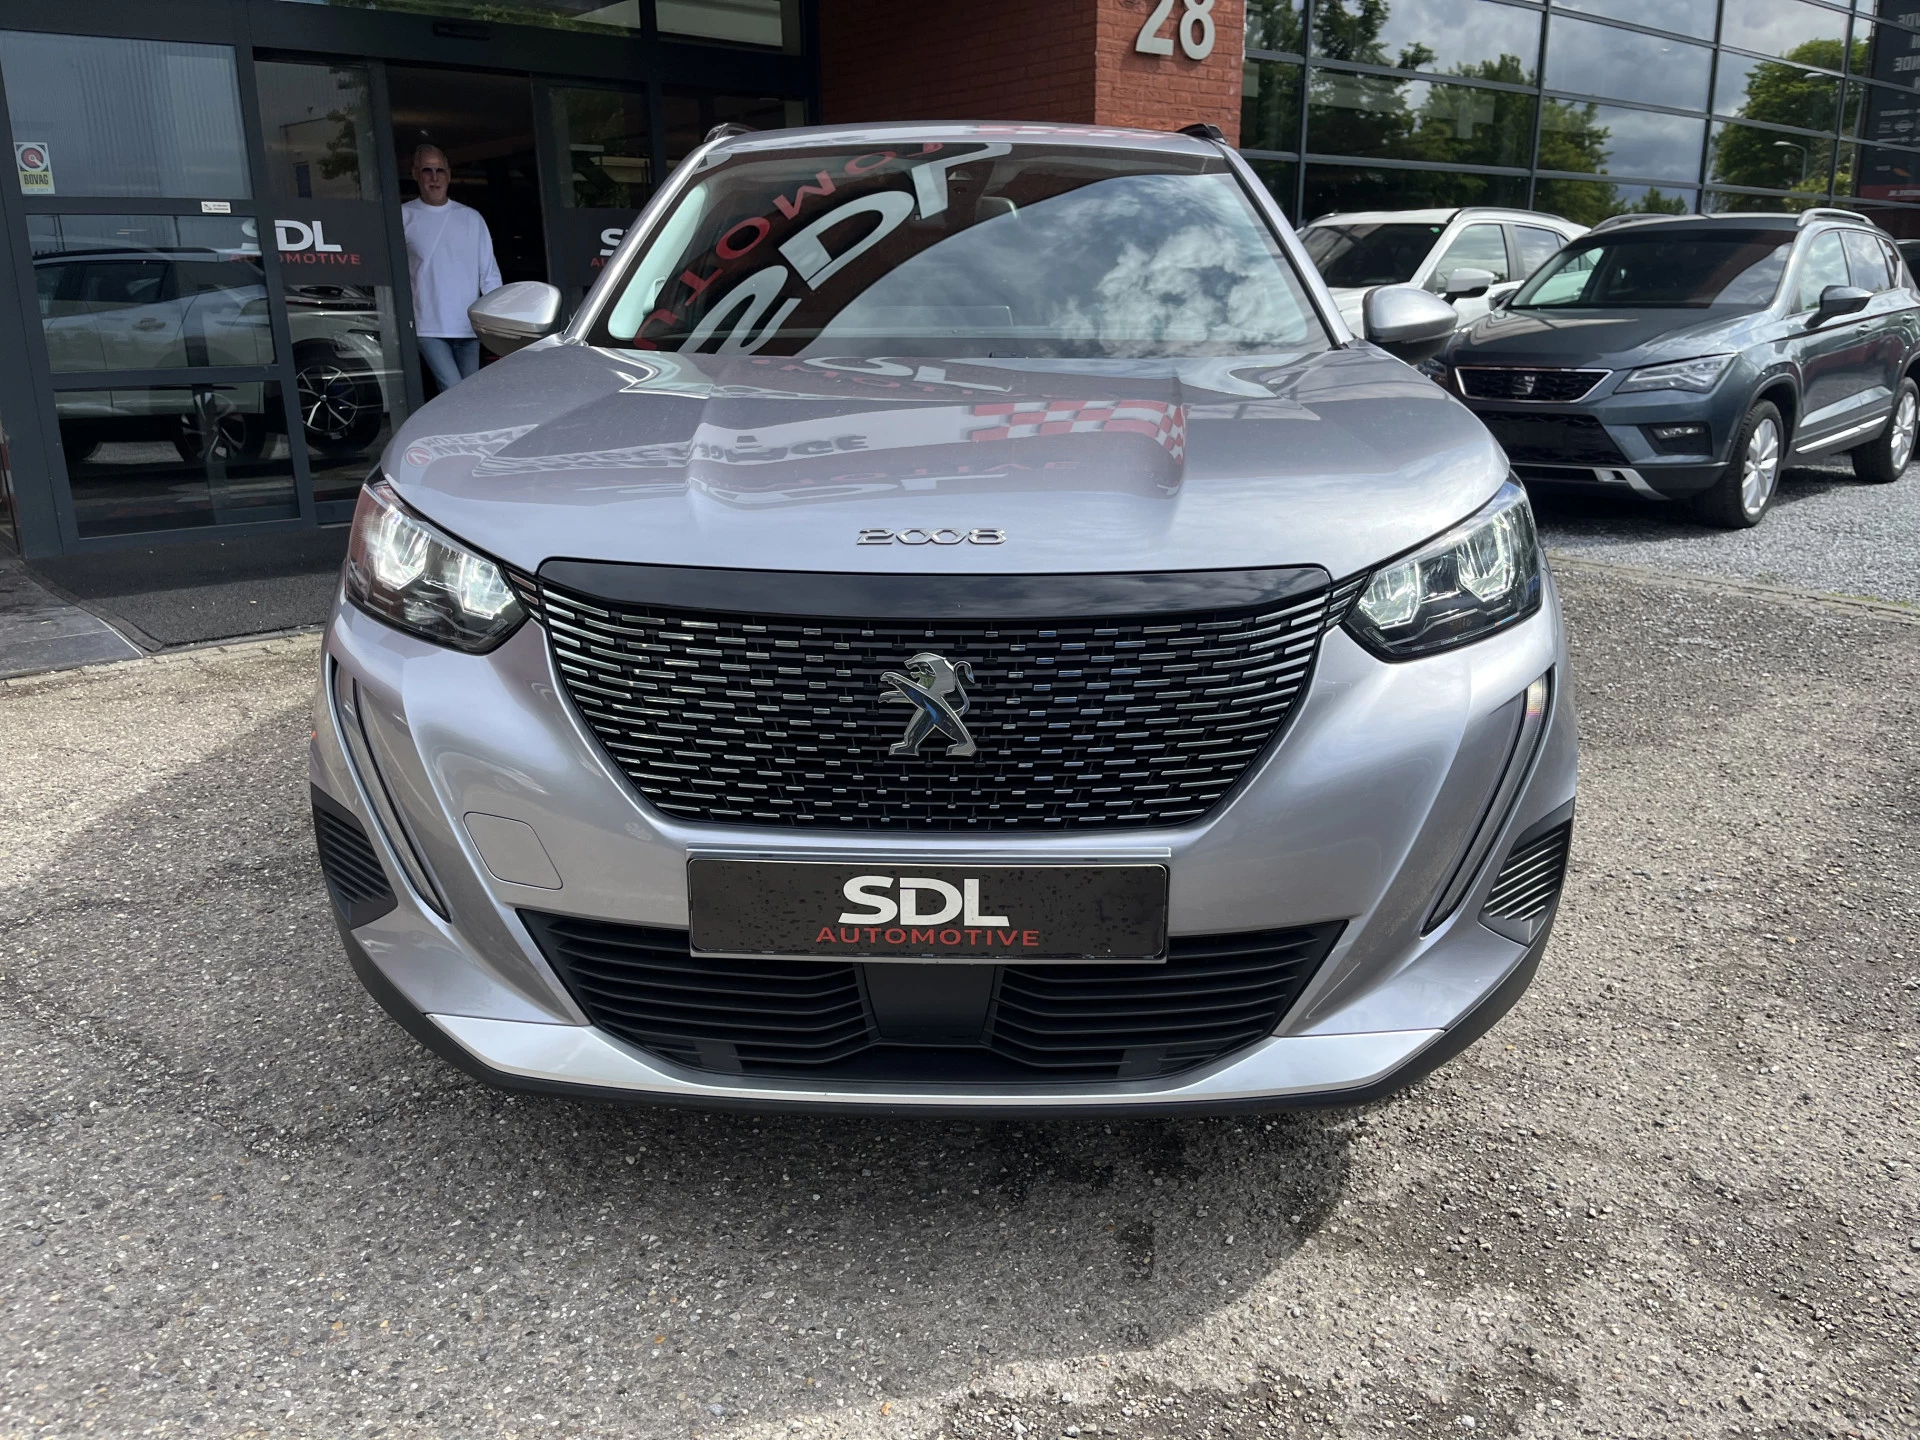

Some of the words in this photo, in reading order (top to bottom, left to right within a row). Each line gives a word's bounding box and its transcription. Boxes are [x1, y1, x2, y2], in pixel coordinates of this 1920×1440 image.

[1135, 0, 1216, 60] 28
[23, 173, 49, 185] BOVAG
[856, 528, 1007, 545] 2008
[838, 875, 1010, 927] SDL
[815, 926, 1041, 947] AUTOMOTIVE
